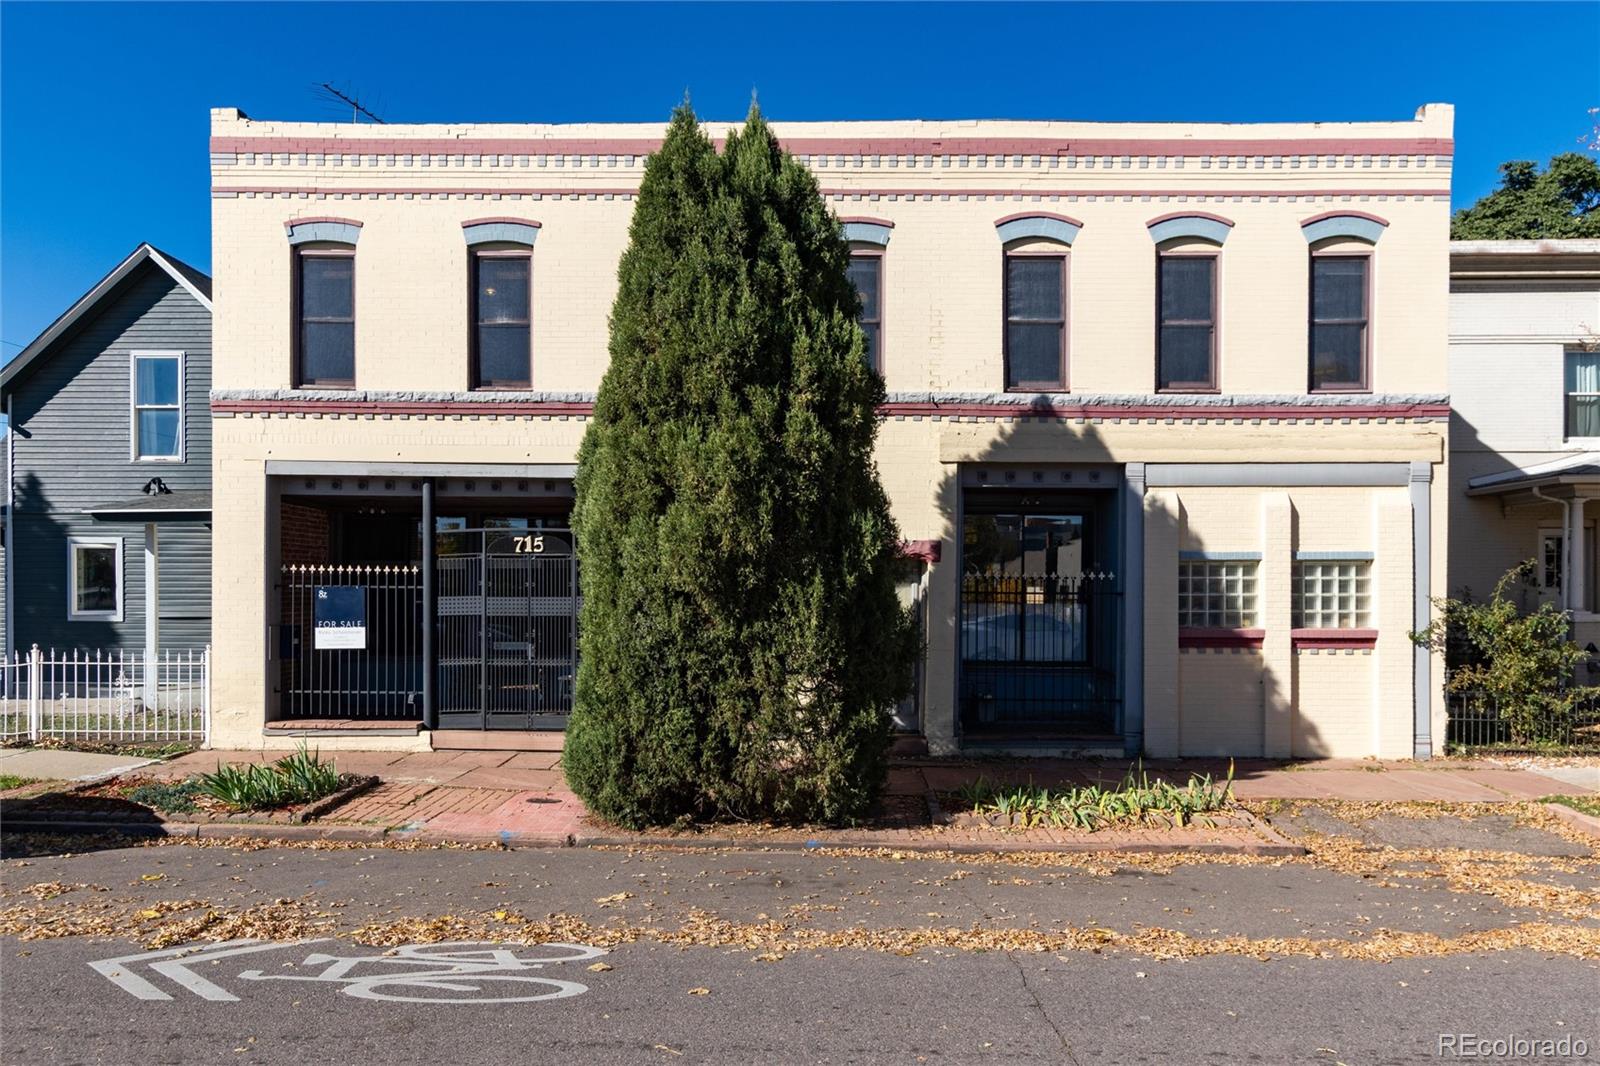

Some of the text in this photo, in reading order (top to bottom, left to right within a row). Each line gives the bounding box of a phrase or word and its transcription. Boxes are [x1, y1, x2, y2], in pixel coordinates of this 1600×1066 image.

[513, 535, 544, 553] 715
[318, 620, 361, 628] FOR SALE
